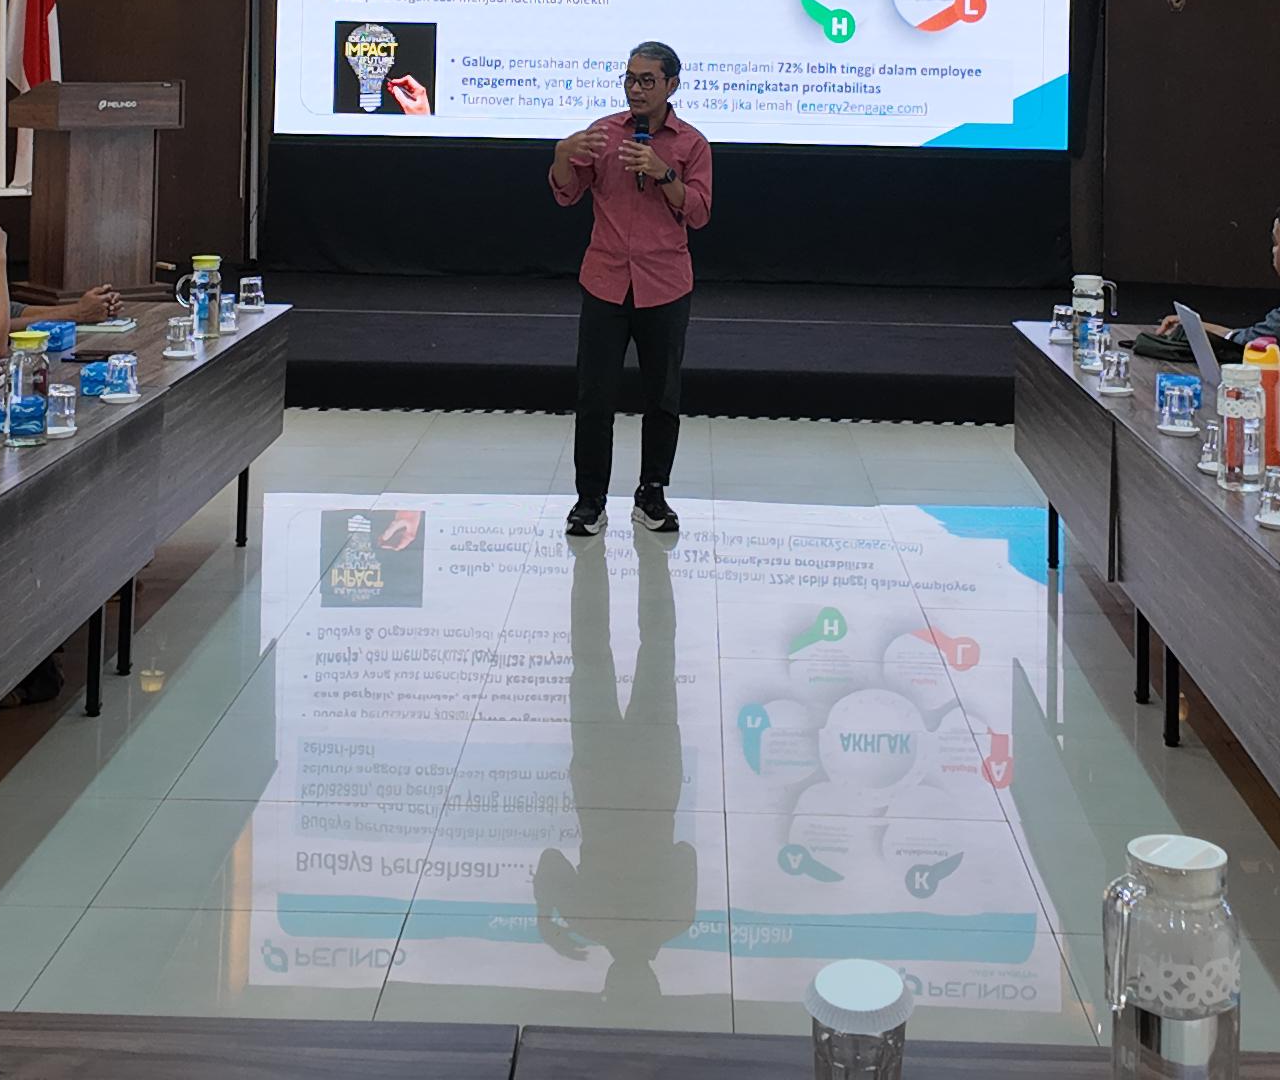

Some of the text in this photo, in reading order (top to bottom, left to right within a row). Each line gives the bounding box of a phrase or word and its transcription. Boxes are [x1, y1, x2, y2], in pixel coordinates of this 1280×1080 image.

[831, 17, 848, 36] H
[345, 41, 399, 57] IMPACT
[462, 56, 505, 70] Gallup,
[509, 58, 579, 70] perusahaan
[583, 58, 627, 72] dengan
[707, 61, 774, 75] mengalami
[777, 62, 803, 74] 72%
[807, 62, 836, 74] lebih
[840, 64, 875, 77] tinggi
[878, 64, 917, 76] dalam
[920, 65, 982, 79] employee
[461, 77, 541, 89] engagement,
[544, 79, 573, 90] yang
[576, 77, 622, 89] berkore
[693, 80, 719, 91] 21%
[723, 81, 799, 94] peningkatan
[802, 82, 881, 95] profitabilitas
[461, 93, 514, 106] Turnover
[518, 94, 554, 108] hanya
[558, 95, 584, 107] 14%
[586, 96, 607, 110] jika
[686, 100, 699, 109] vs
[702, 98, 728, 110] 48%
[730, 99, 752, 113] jika
[755, 99, 793, 111] lemah
